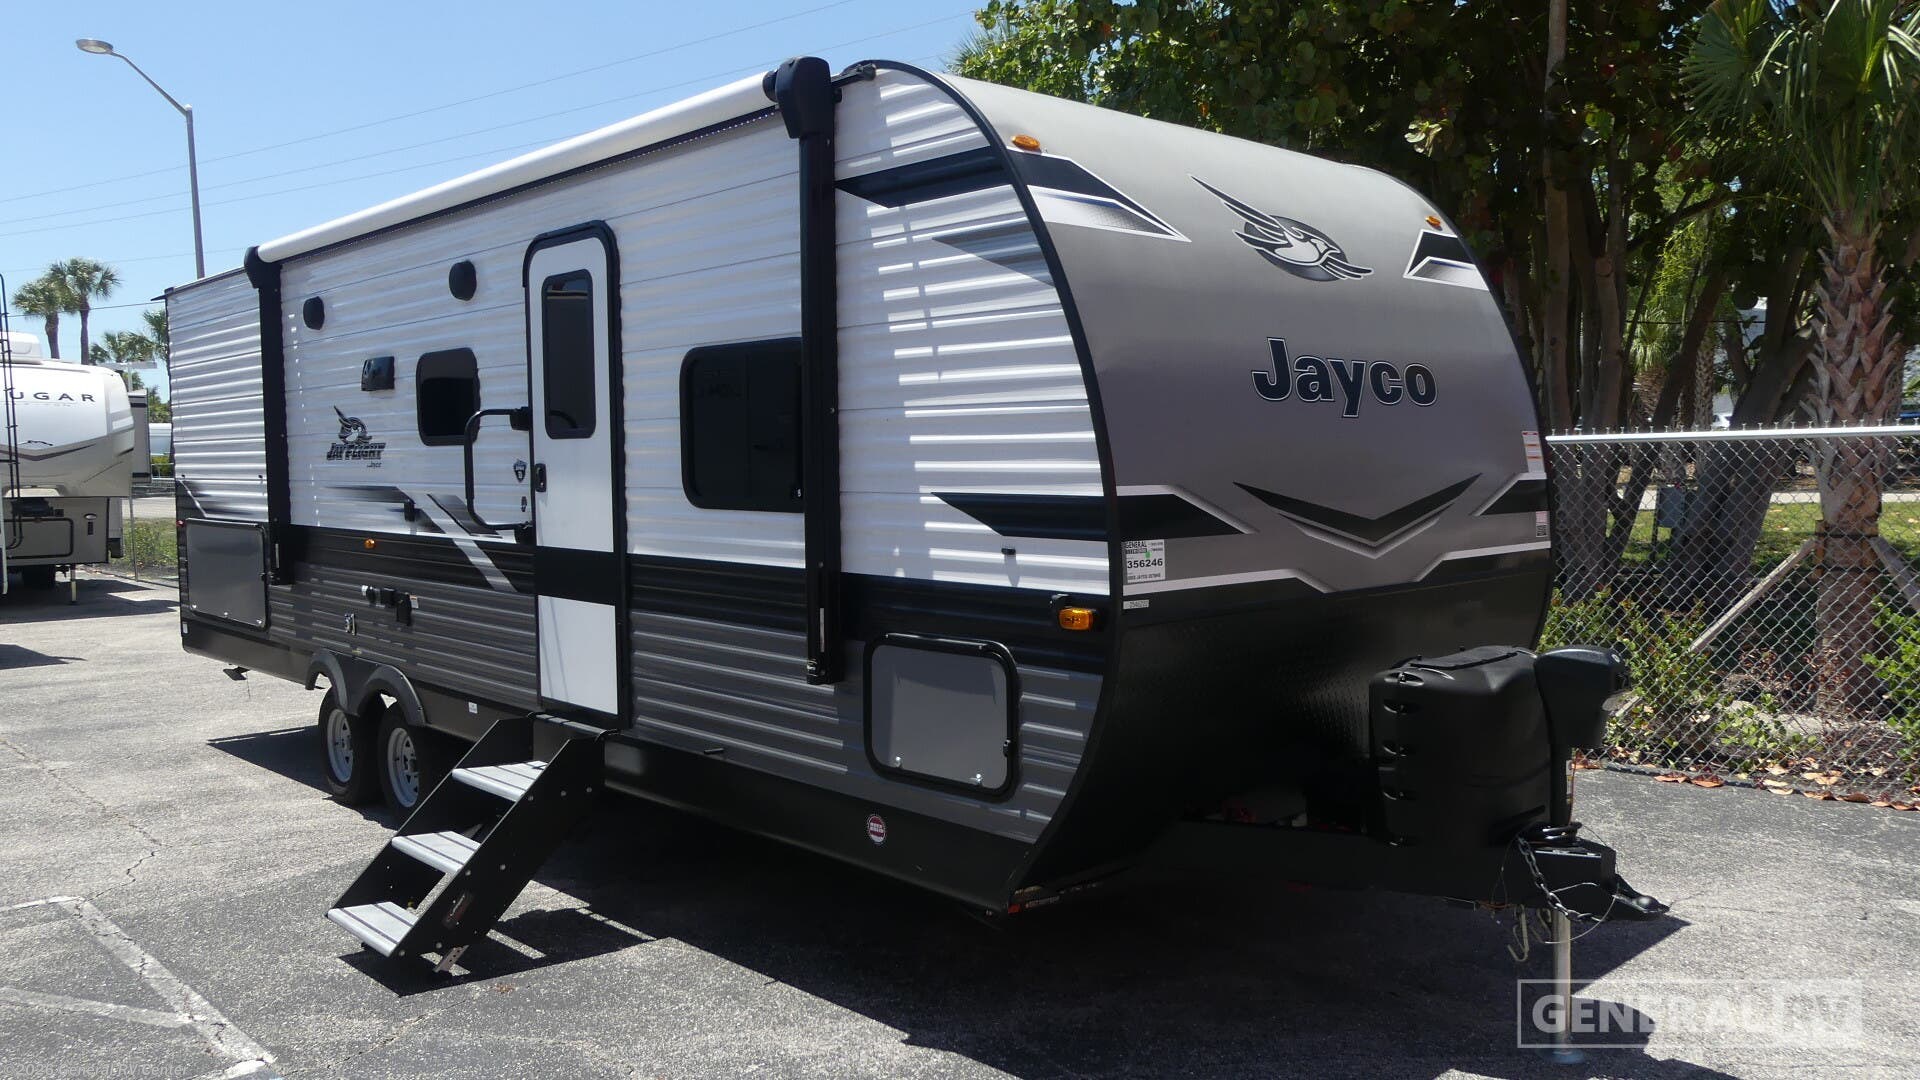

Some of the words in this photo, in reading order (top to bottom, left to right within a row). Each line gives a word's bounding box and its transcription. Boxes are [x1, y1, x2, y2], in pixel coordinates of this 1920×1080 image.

[1250, 337, 1438, 418] Jayco
[327, 443, 347, 461] JAY
[345, 443, 386, 461] FLIGHT
[1127, 558, 1163, 568] 356246
